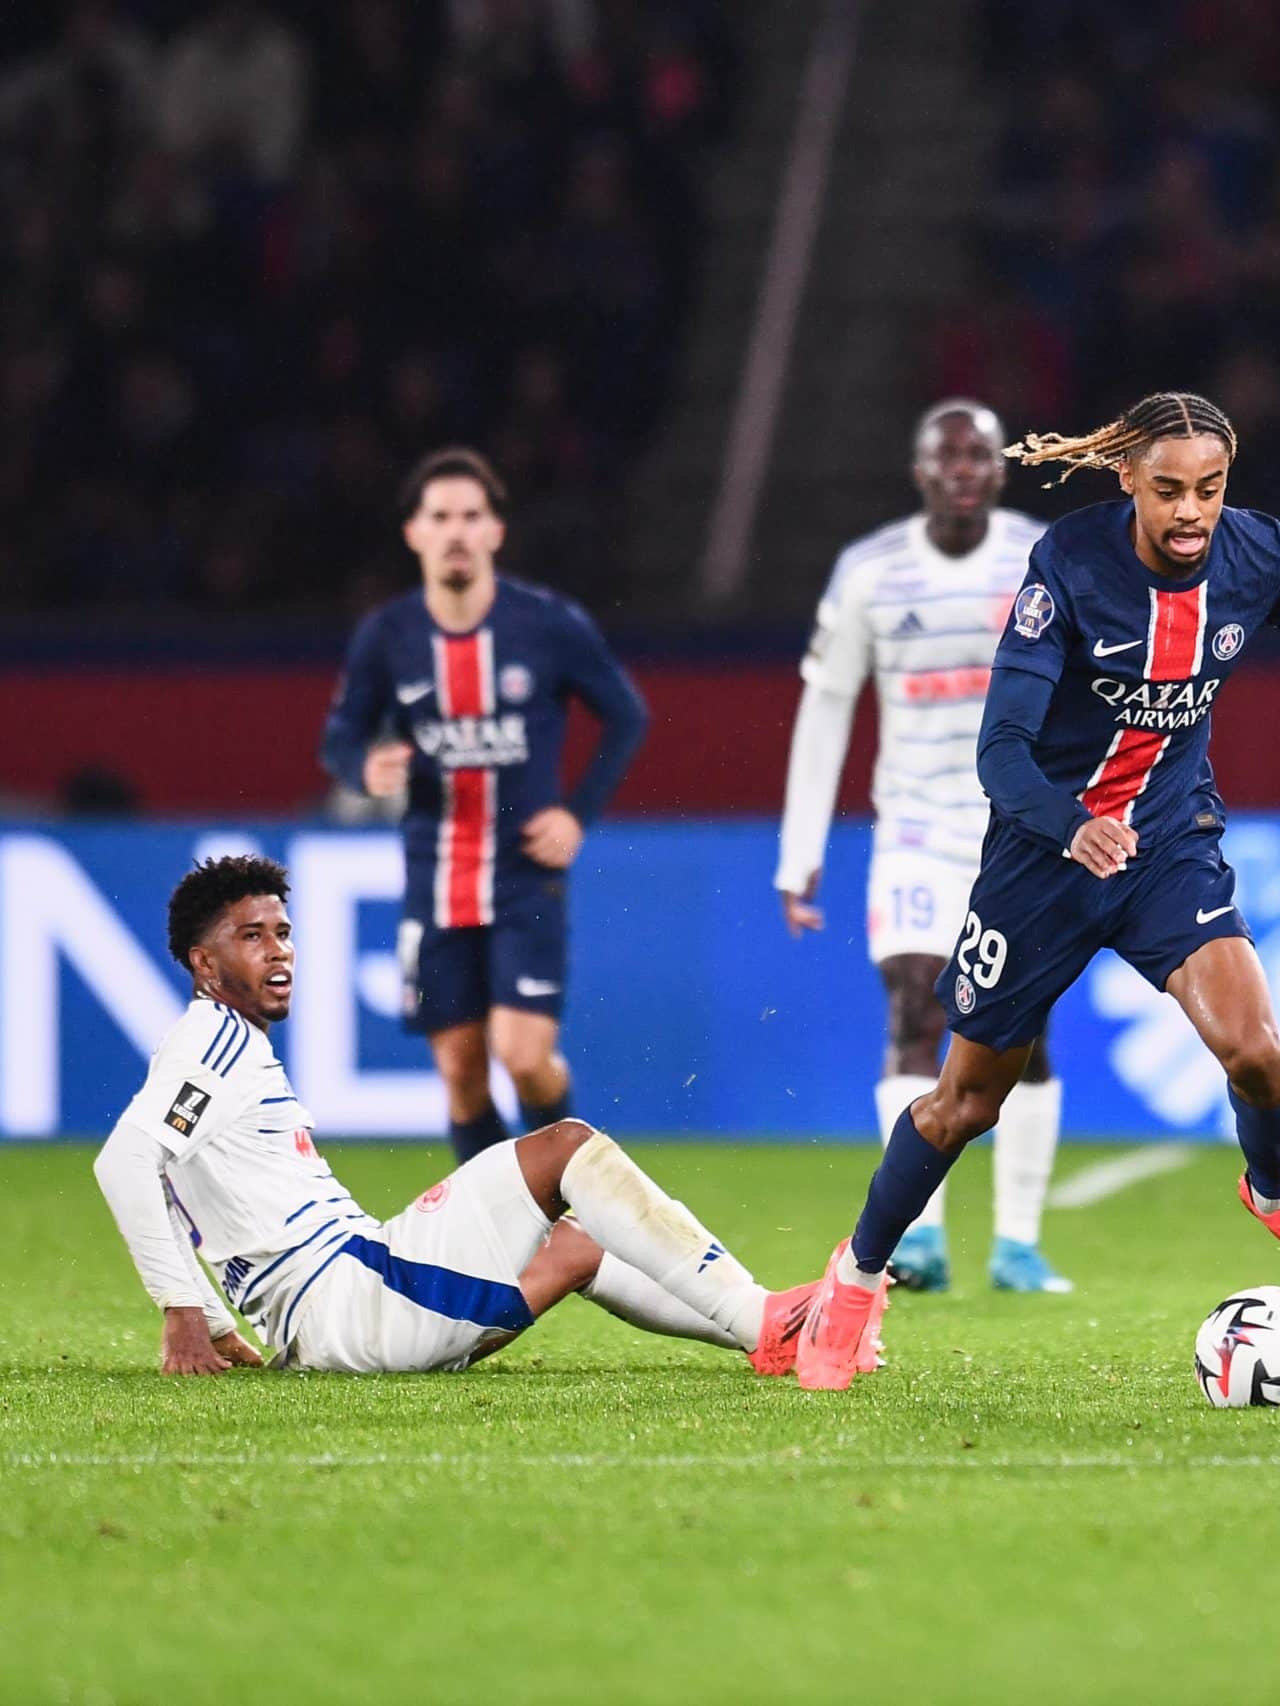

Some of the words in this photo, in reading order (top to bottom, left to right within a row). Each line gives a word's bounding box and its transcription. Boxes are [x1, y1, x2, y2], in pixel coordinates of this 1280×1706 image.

[1091, 678, 1220, 709] QATAR
[890, 885, 936, 935] 19
[957, 910, 1009, 989] 29
